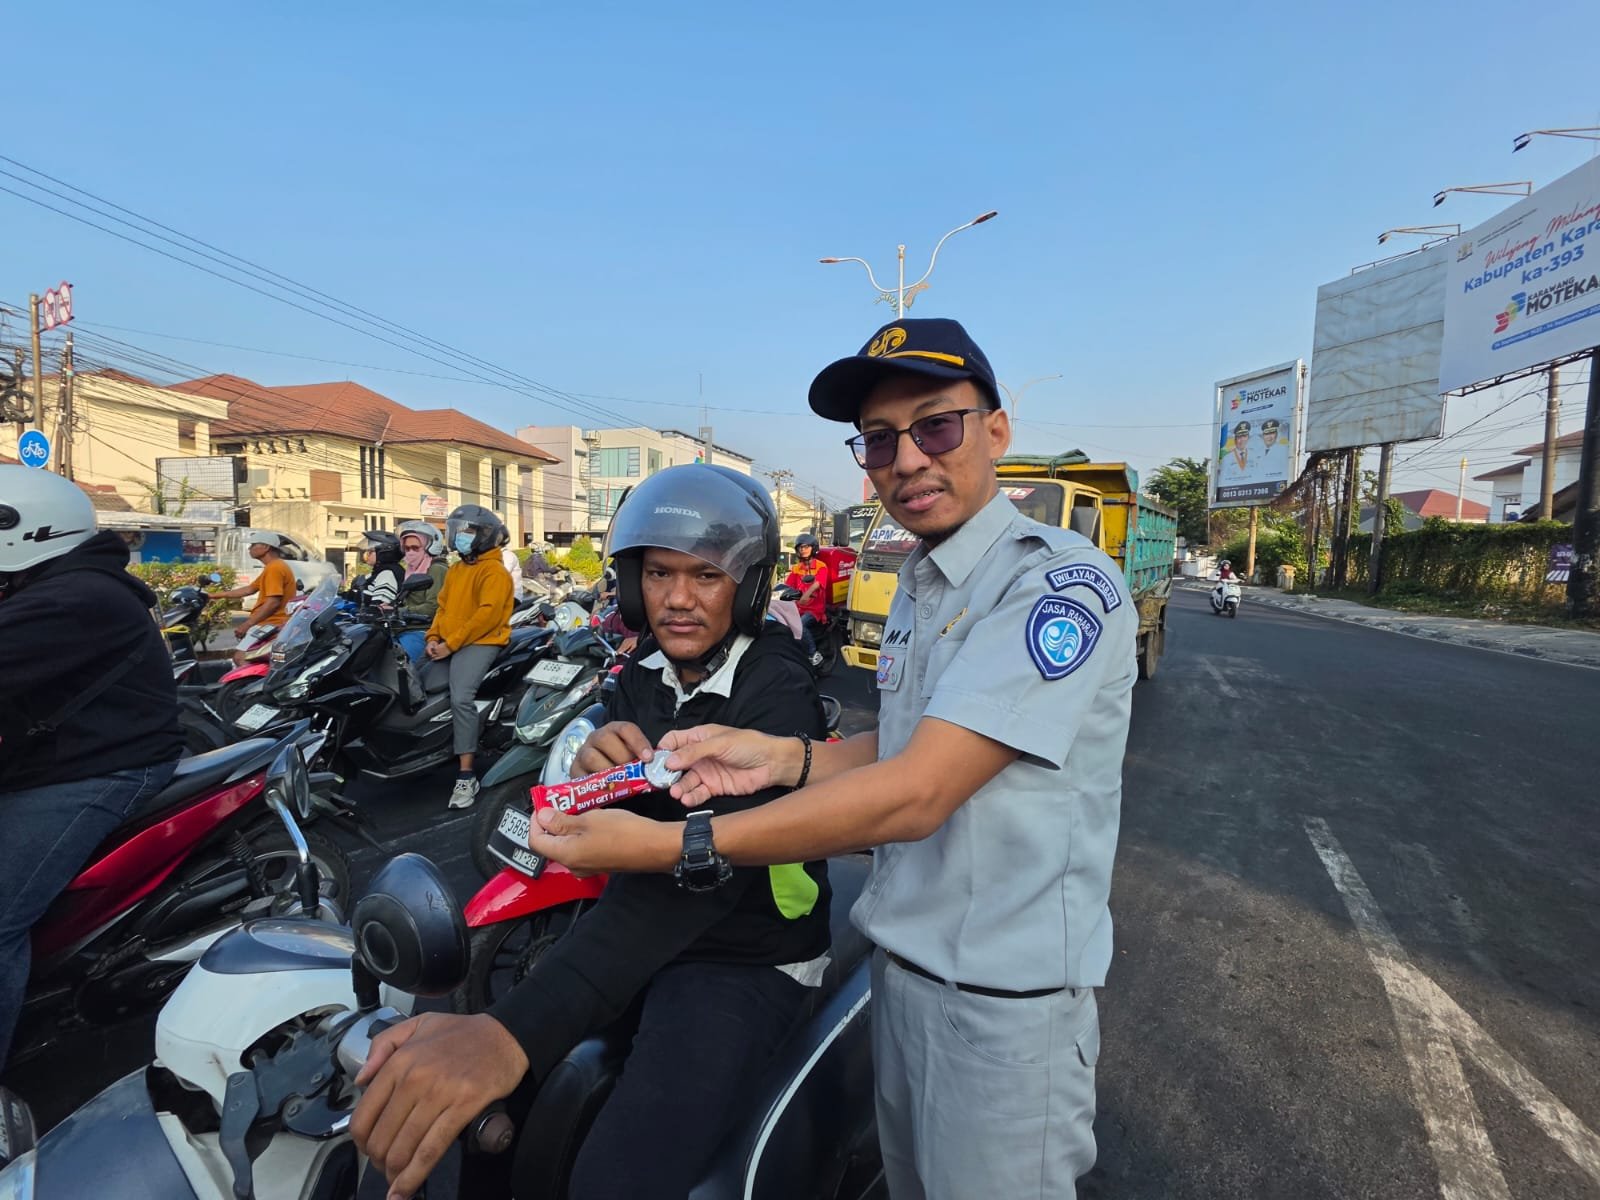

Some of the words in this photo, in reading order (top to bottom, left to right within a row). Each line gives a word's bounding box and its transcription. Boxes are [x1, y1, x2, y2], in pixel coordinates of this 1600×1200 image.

[1464, 241, 1554, 293] Kabupaten
[1521, 244, 1585, 285] ka-393
[1526, 274, 1600, 316] MOTEKA
[1528, 276, 1575, 300] KARAWANG
[1247, 386, 1287, 404] MOTEKAR
[654, 506, 702, 519] HONDA
[871, 529, 895, 541] APM
[1055, 570, 1096, 583] WILAYAH
[1096, 577, 1115, 605] JABAR
[1042, 603, 1066, 616] JASA
[1067, 609, 1095, 640] RAHARJA
[577, 800, 591, 810] BUY
[596, 794, 609, 804] GET
